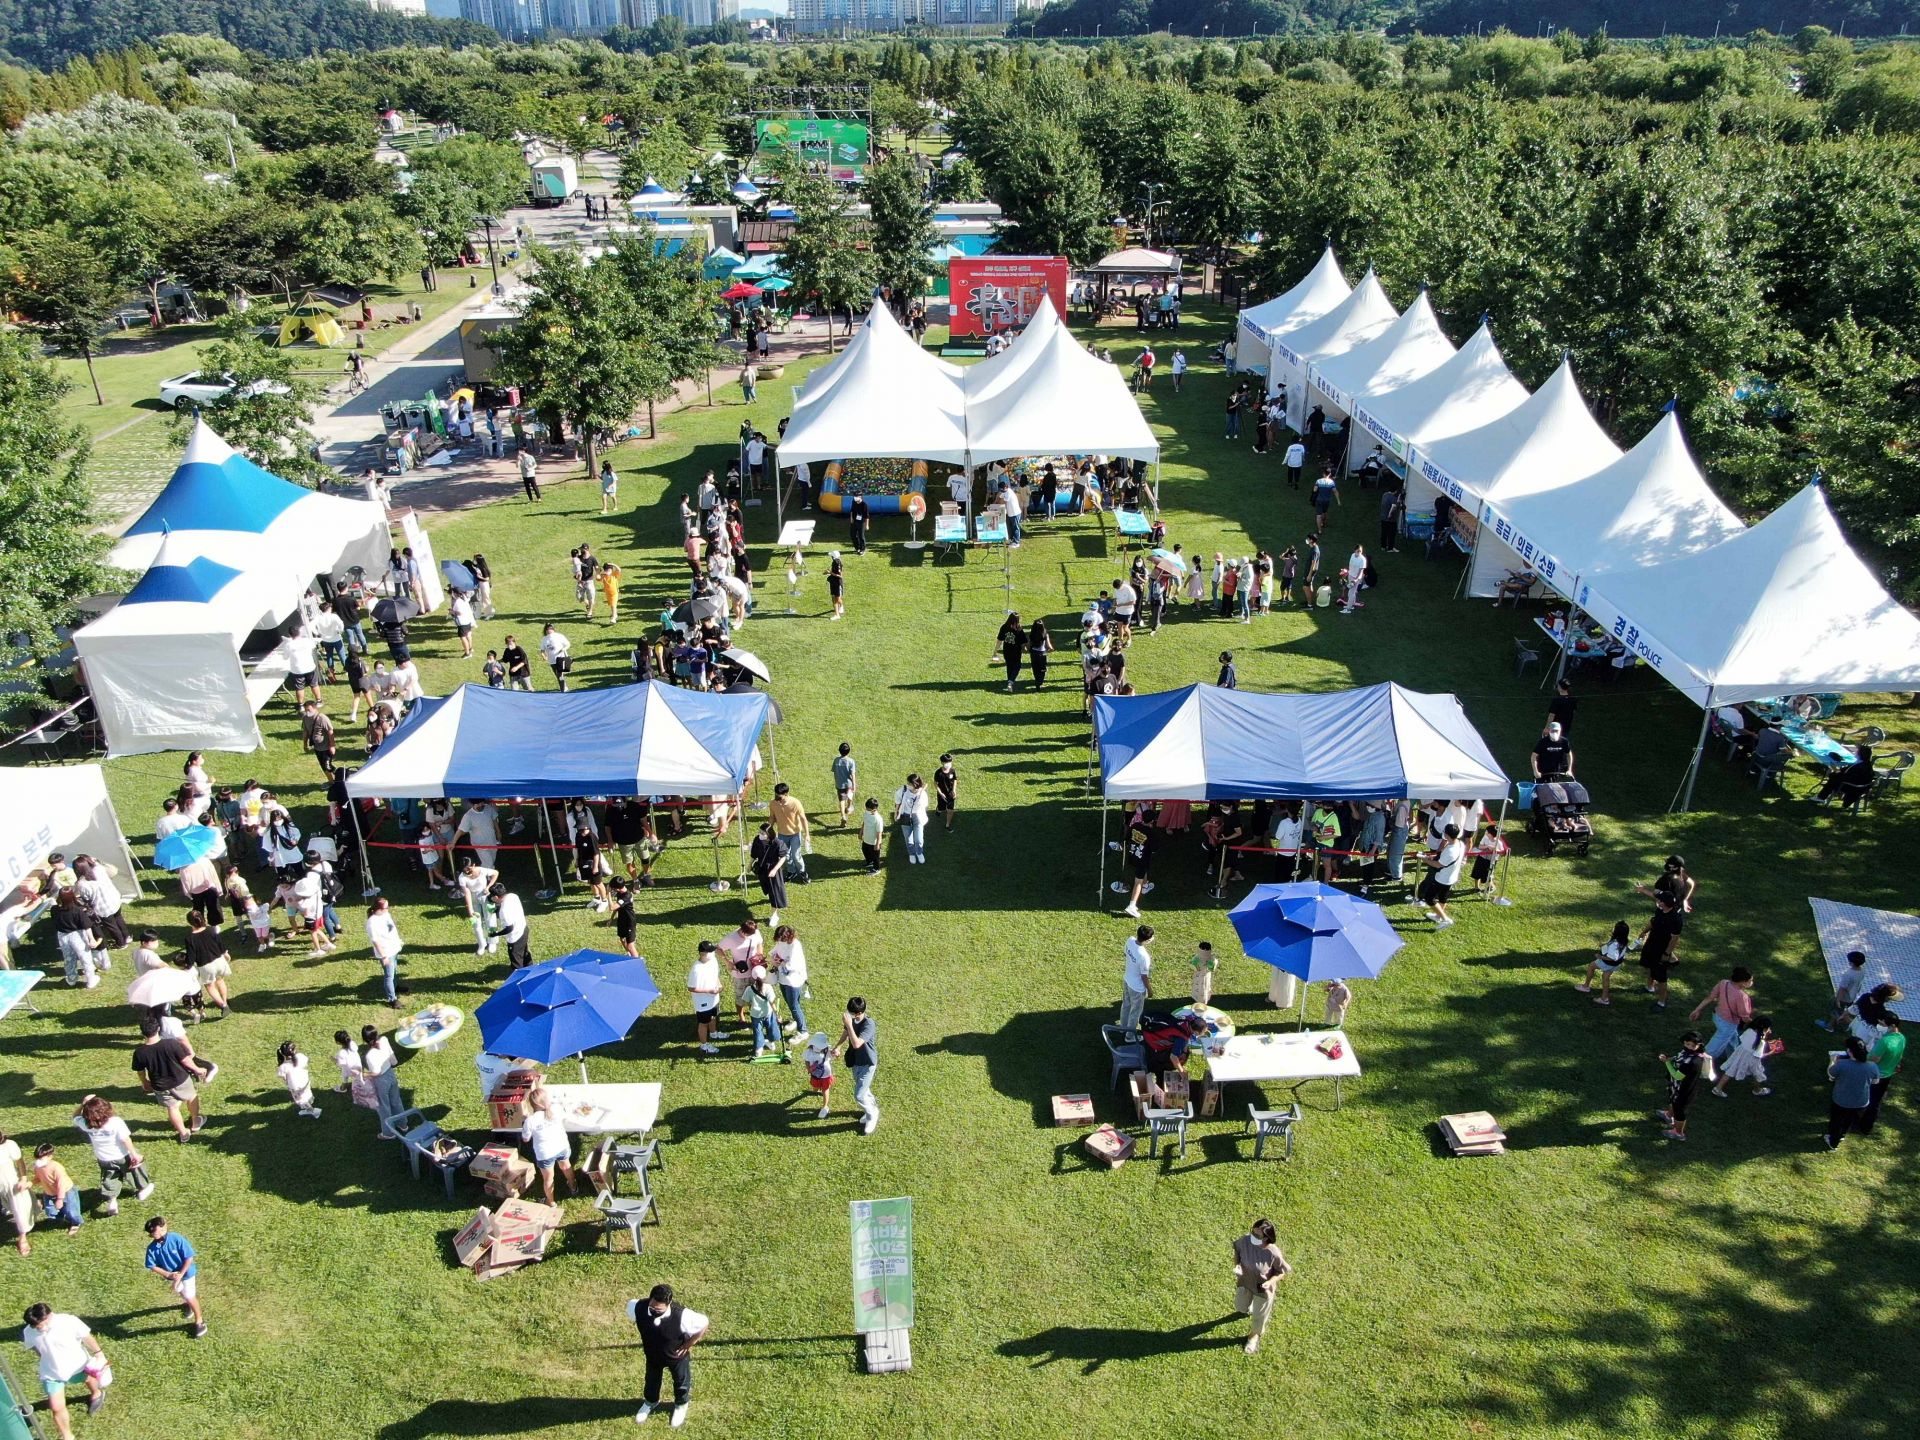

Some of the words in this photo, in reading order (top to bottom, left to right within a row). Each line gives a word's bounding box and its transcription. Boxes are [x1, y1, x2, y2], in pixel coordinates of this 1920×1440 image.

[1421, 460, 1451, 492] 자원봉사자
[1449, 483, 1464, 503] 쉼터
[1495, 518, 1512, 542] 응급
[1516, 536, 1534, 561] 의료
[1537, 555, 1556, 579] 소방
[1637, 641, 1663, 669] POLICE
